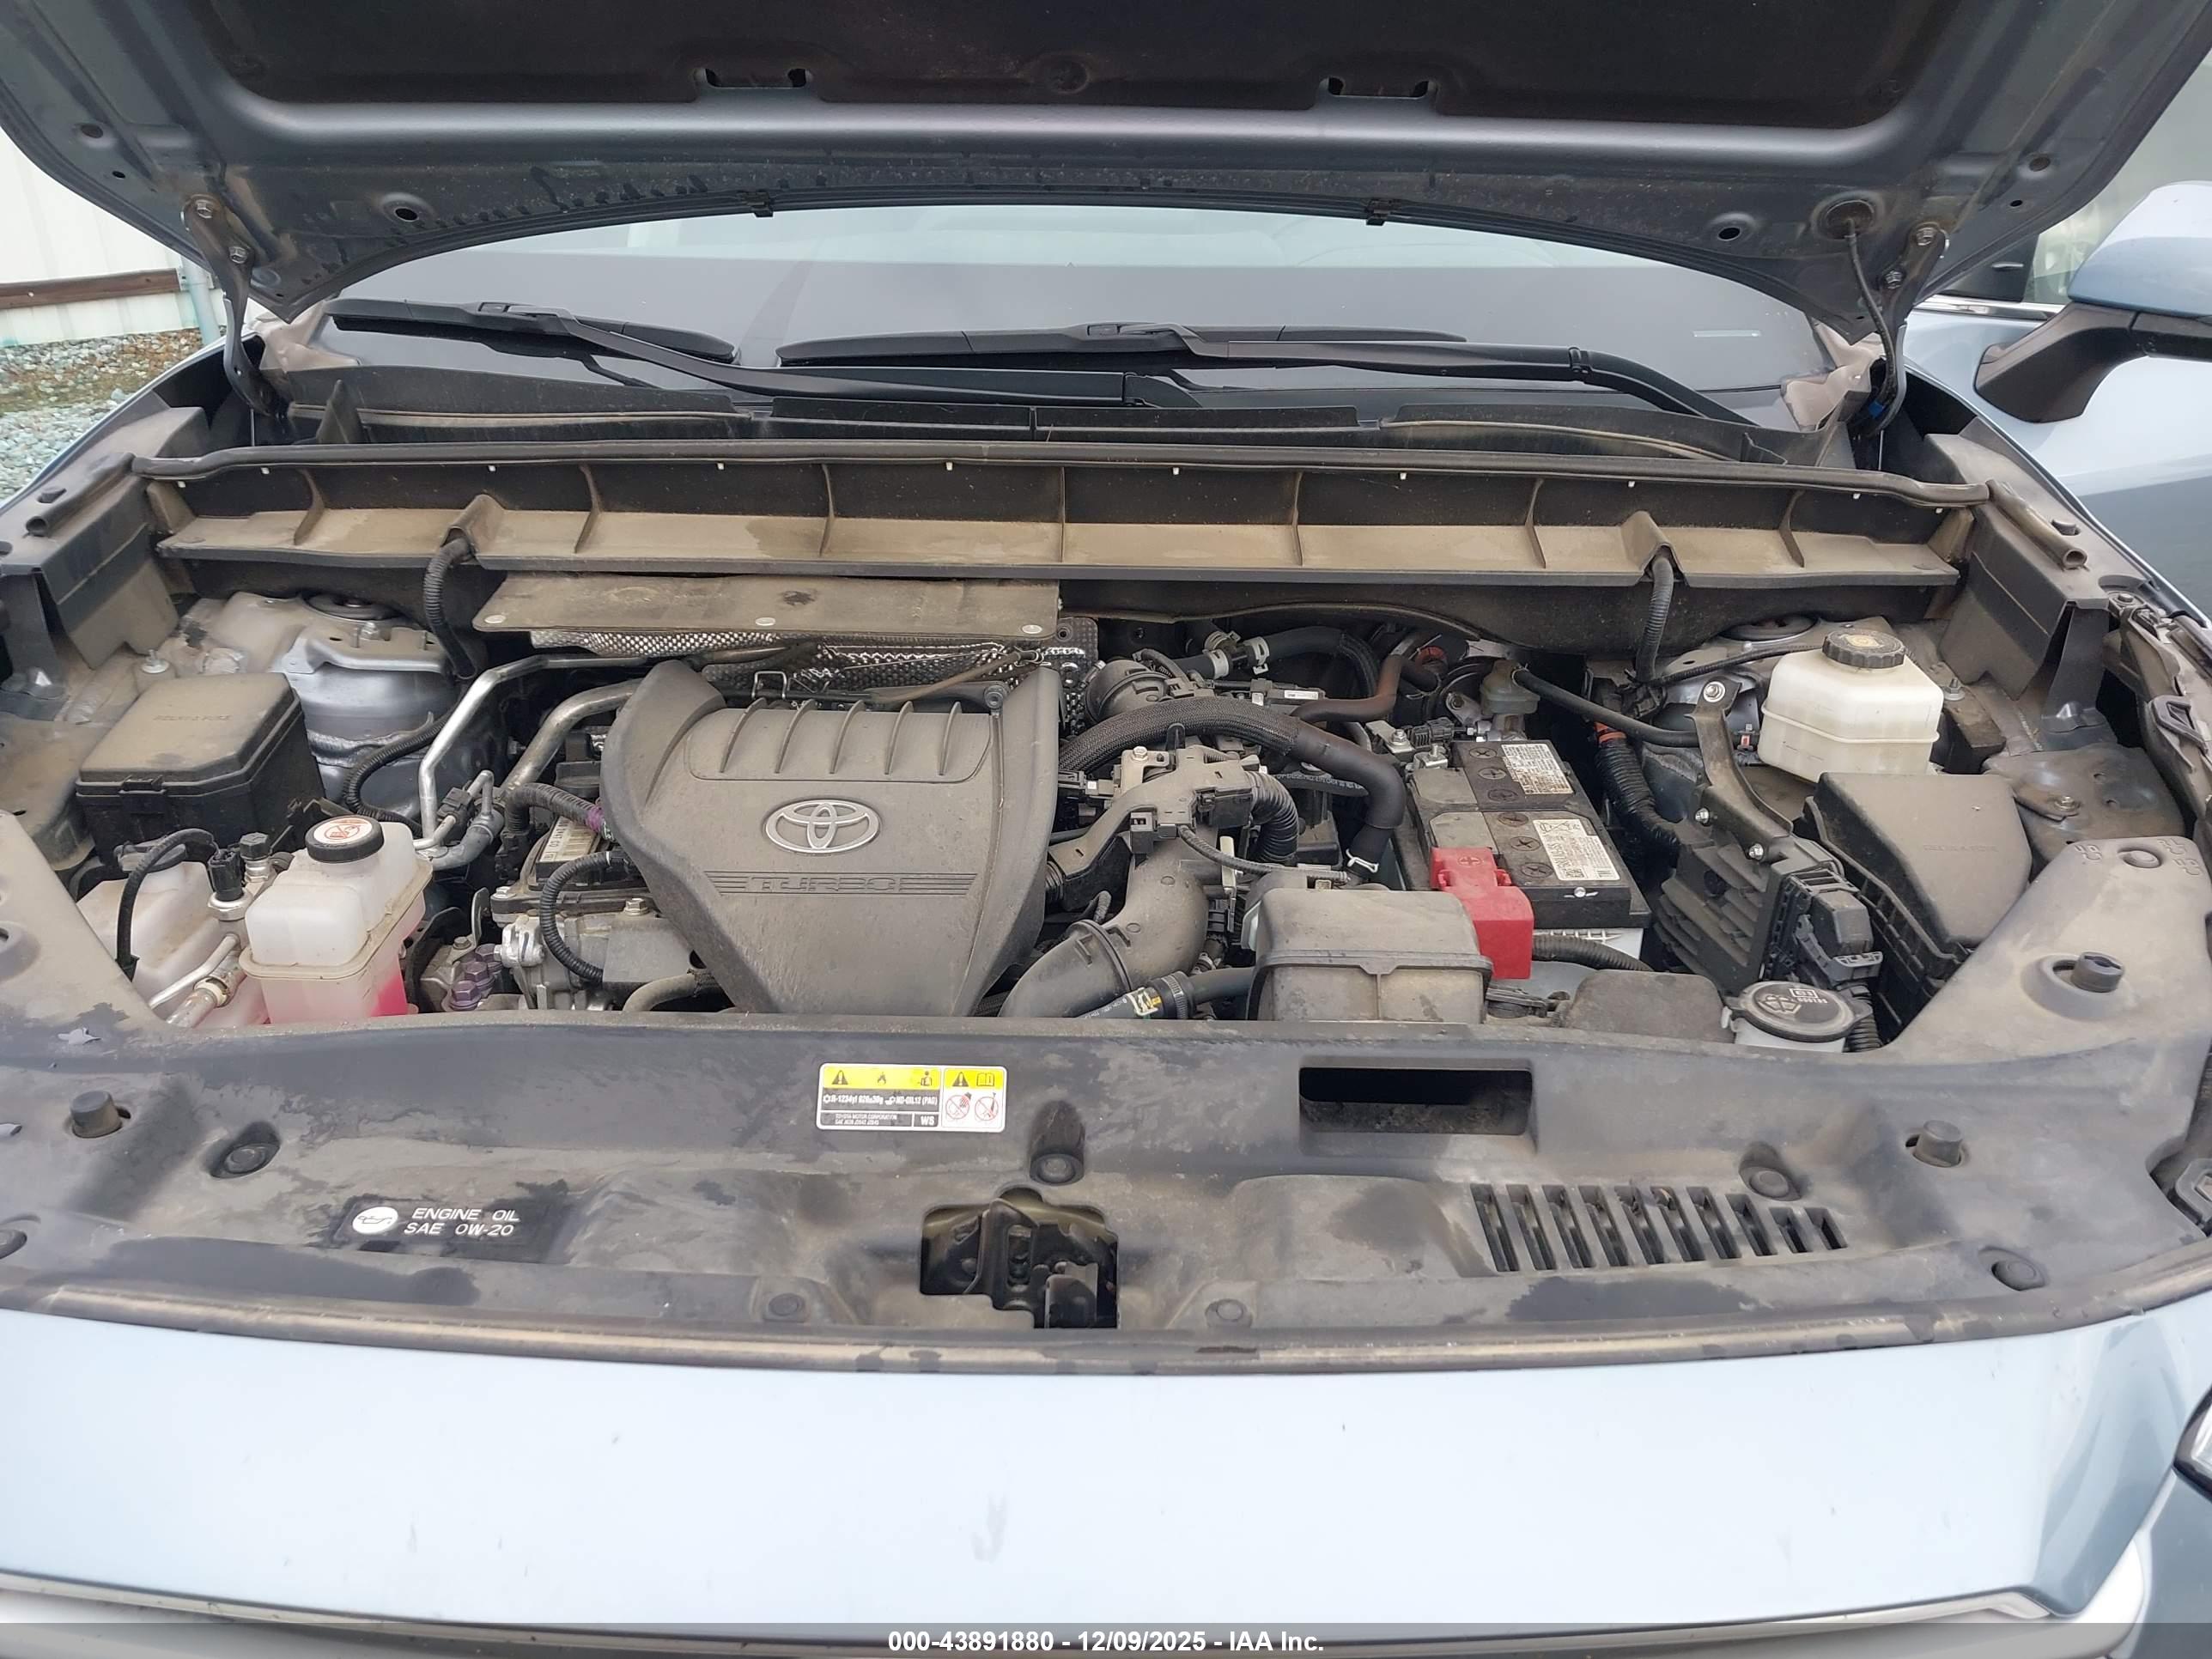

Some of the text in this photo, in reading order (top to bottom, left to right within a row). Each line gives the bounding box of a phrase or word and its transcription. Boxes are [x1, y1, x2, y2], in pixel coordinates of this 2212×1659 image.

[920, 1115, 935, 1126] WS
[411, 1207, 520, 1221] ENGINE OIL
[404, 1222, 514, 1235] SAE 0W-20
